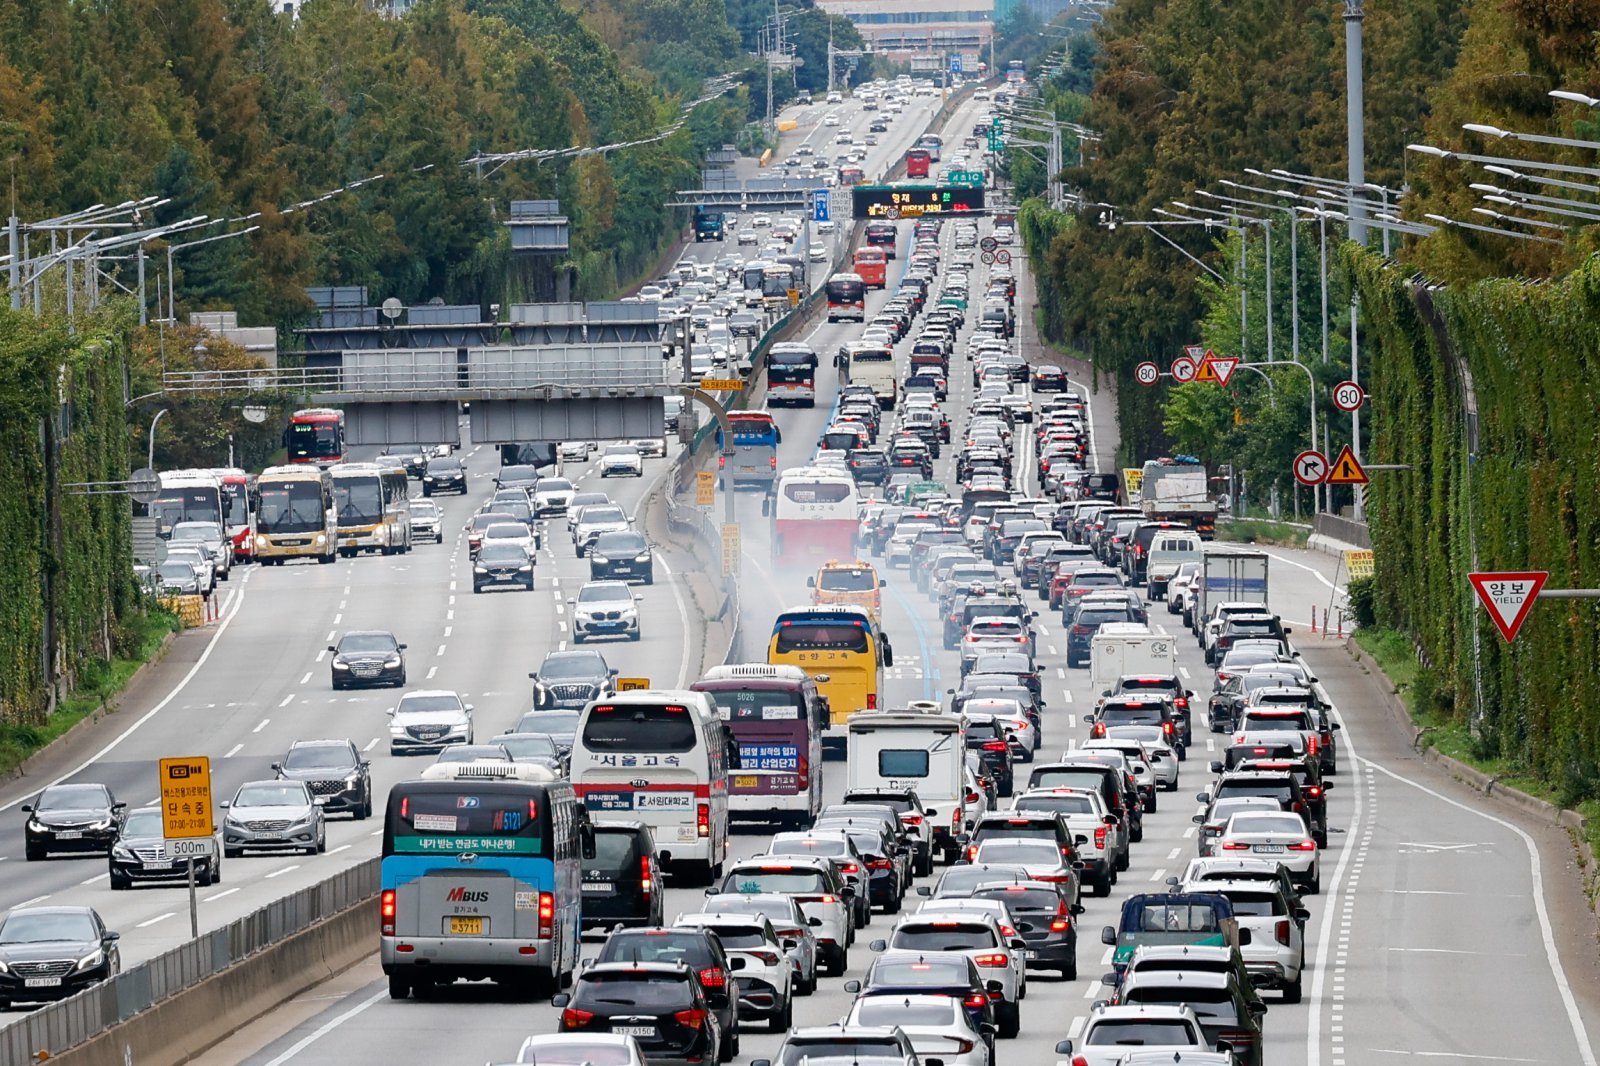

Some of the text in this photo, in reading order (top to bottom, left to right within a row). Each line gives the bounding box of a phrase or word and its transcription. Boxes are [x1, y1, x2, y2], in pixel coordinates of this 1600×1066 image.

[1140, 368, 1155, 380] 80
[1339, 389, 1358, 404] 80
[1490, 582, 1526, 596] 양보
[1493, 596, 1523, 604] YIELD
[737, 692, 755, 701] 5026
[782, 747, 796, 756] 입지
[761, 758, 797, 768] 산업단지
[770, 776, 795, 784] 경기고속
[163, 786, 208, 798] 버스전용차로위반
[647, 796, 690, 806] 서원대학교
[169, 818, 206, 831] 07:00-21:00
[174, 841, 205, 854] 500m
[419, 839, 516, 850] 내가 받는 연금도 하나은행!
[446, 887, 489, 902] MBUS
[454, 905, 478, 913] 경기고속
[632, 1027, 652, 1035] 6150
